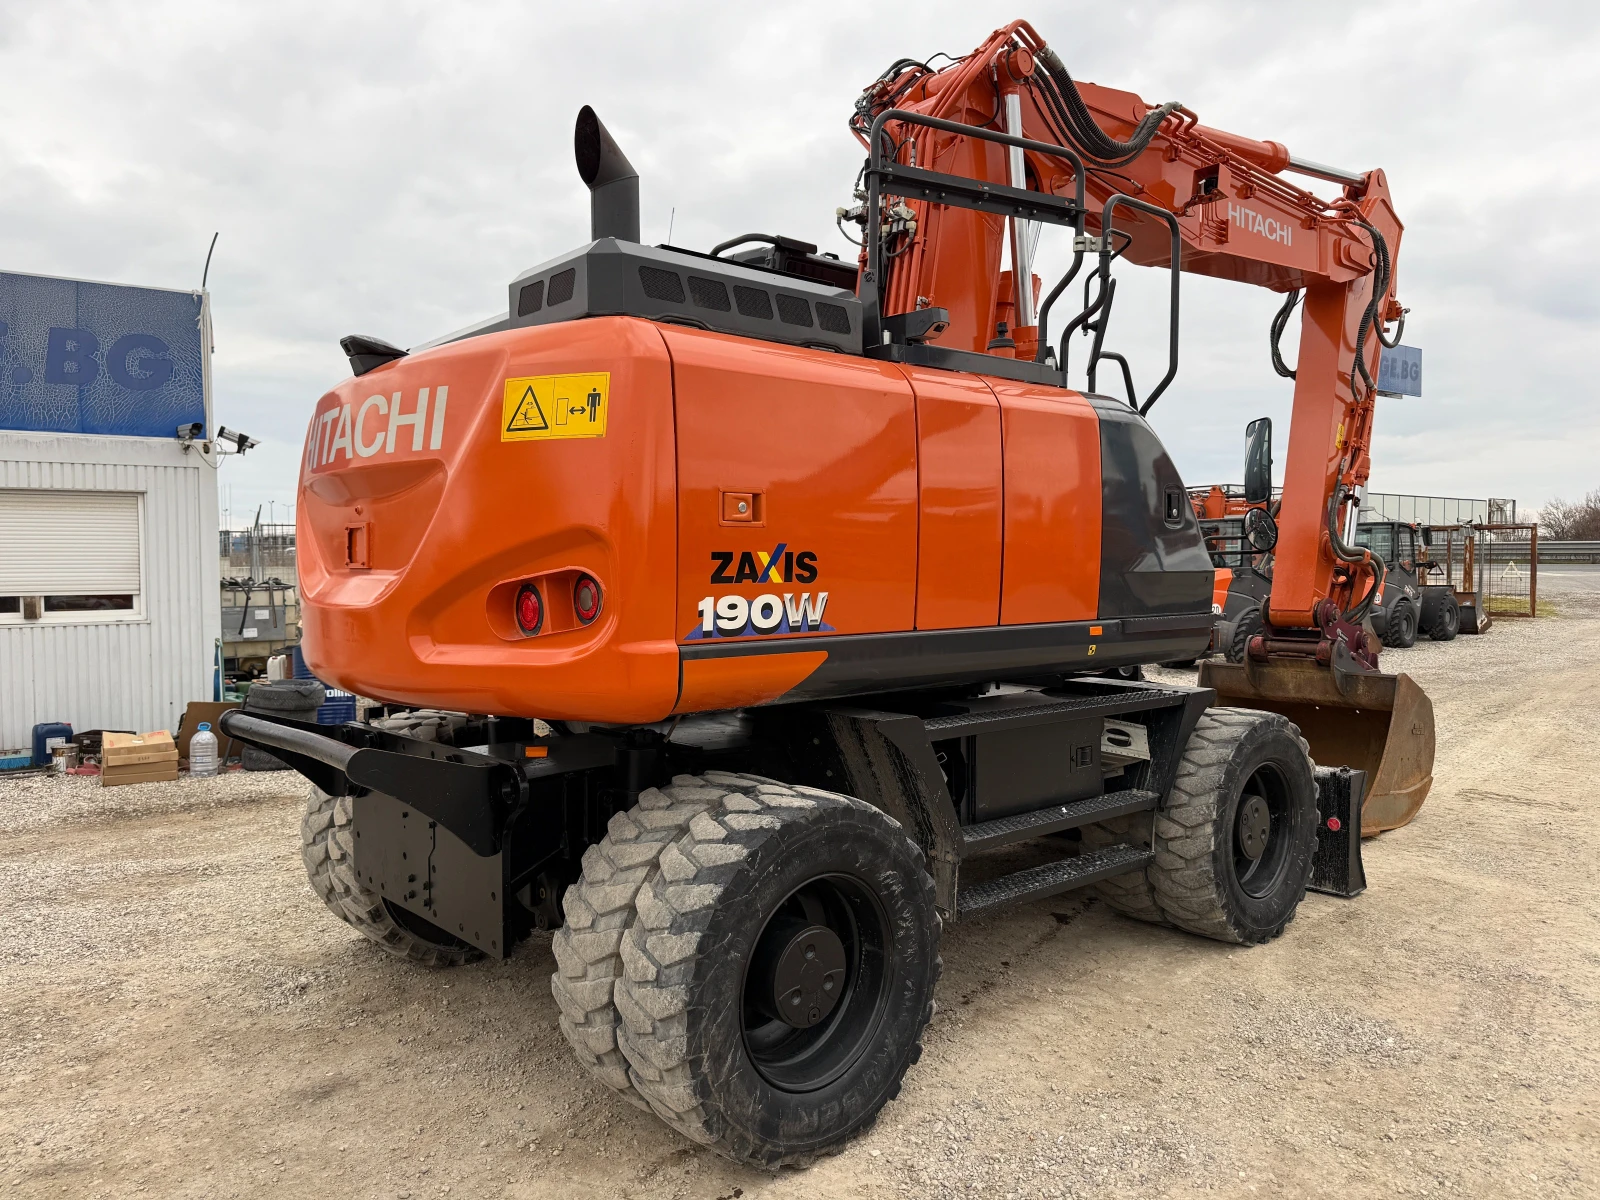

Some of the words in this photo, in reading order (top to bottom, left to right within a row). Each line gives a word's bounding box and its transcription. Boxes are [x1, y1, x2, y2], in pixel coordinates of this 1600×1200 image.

[1228, 202, 1292, 247] HITACHI
[308, 385, 449, 471] HITACHI
[711, 543, 818, 584] ZAXIS
[698, 592, 829, 636] 190W
